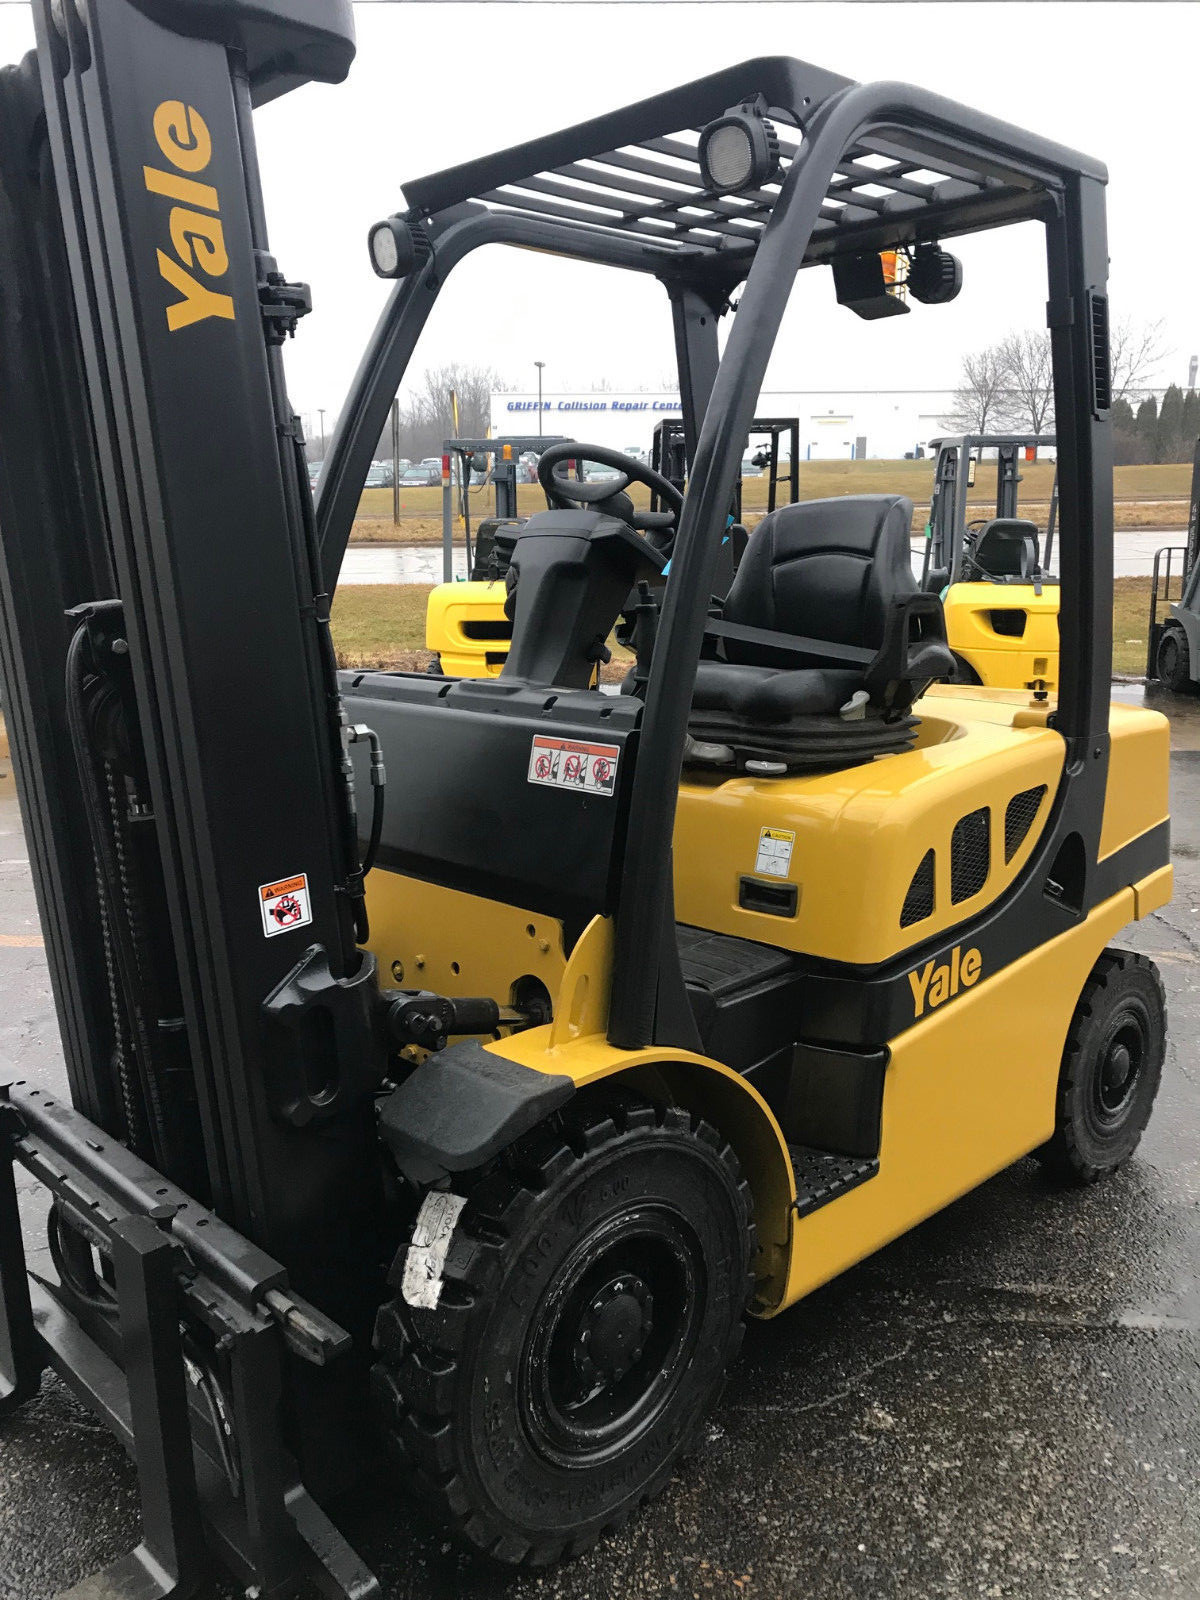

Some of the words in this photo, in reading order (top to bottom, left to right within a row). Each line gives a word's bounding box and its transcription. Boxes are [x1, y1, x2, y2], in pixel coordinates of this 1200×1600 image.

[144, 101, 234, 331] Yale
[507, 401, 551, 411] GRIFFIN
[558, 401, 607, 411] Collision
[611, 401, 649, 412] Repair
[274, 880, 303, 894] WARNING
[908, 946, 982, 1018] Yale
